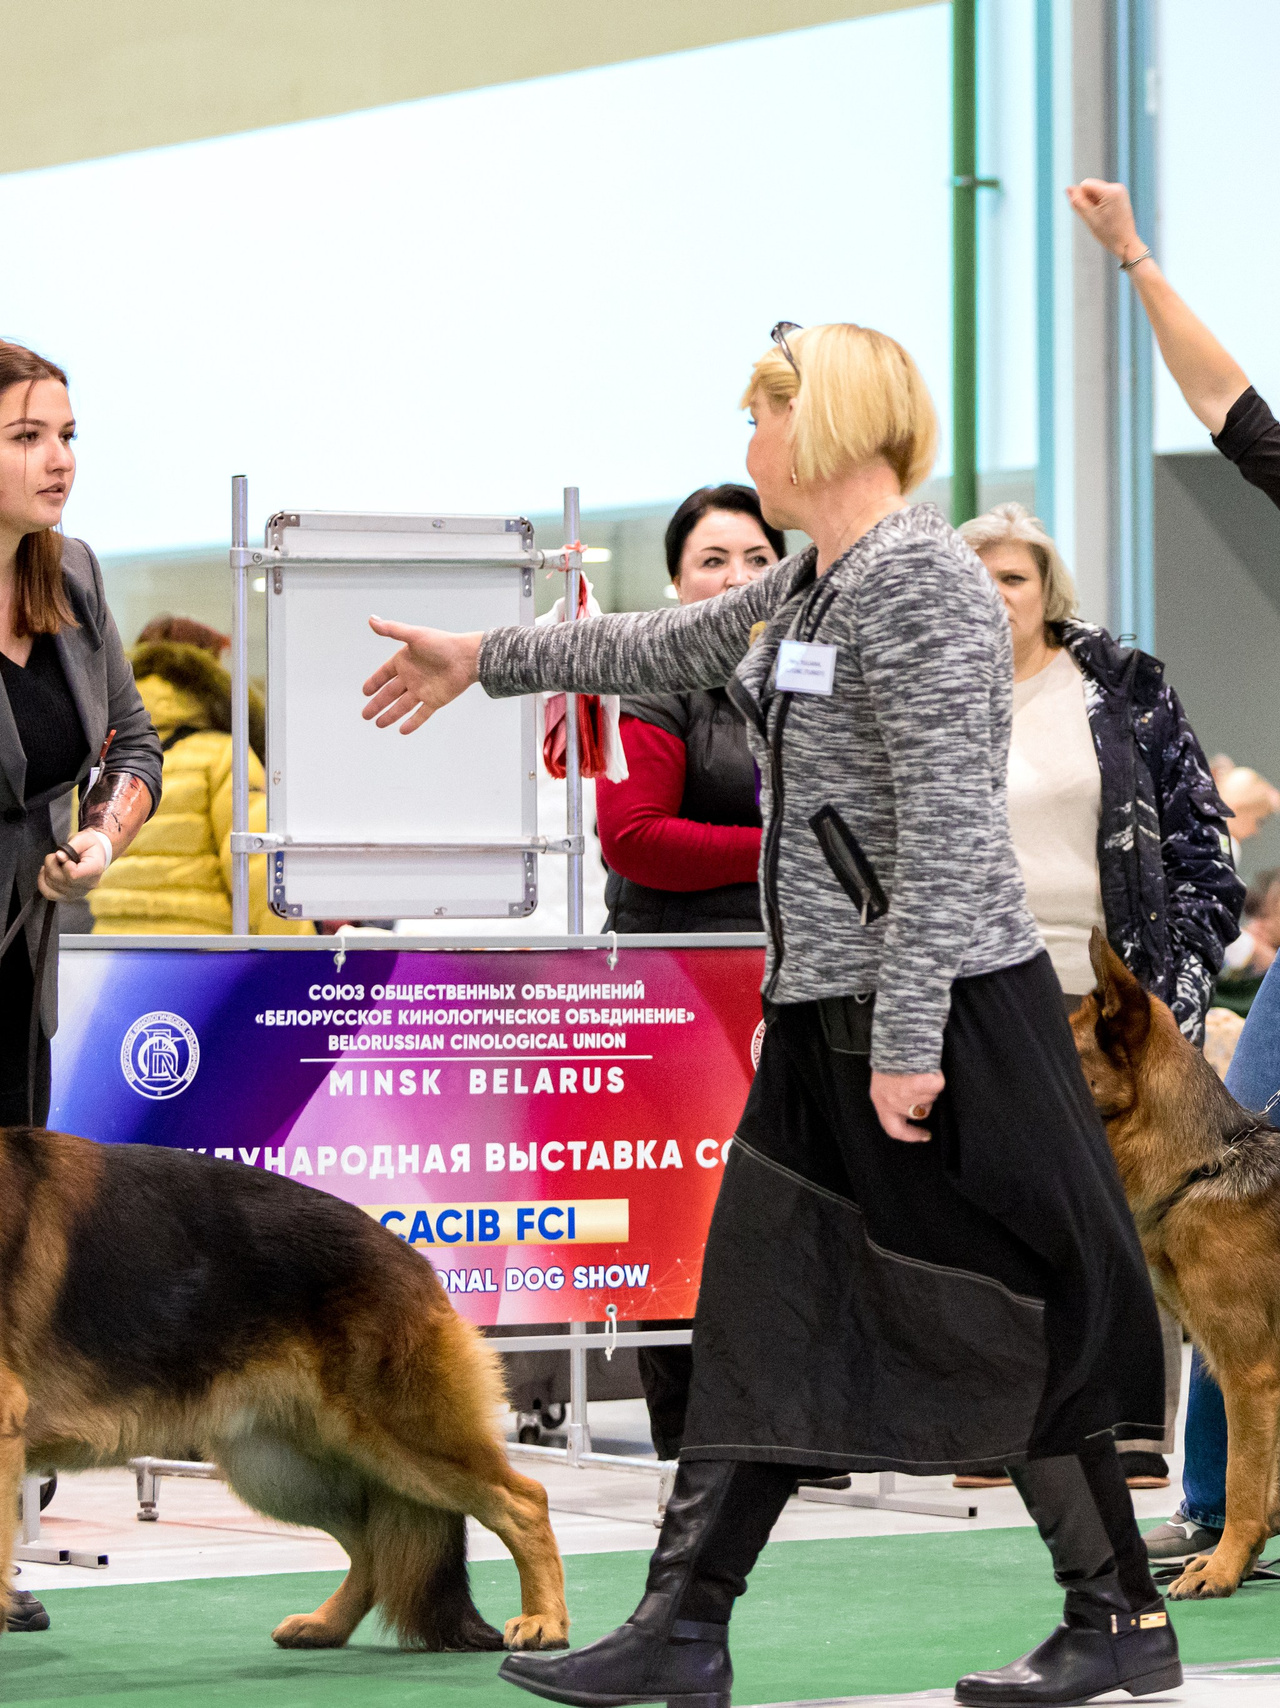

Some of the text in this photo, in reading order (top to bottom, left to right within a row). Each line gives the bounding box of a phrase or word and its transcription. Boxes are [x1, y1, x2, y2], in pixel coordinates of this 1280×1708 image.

[308, 979, 645, 1003] СОЮЗ ОБЩЕСТВЕННЫХ ОБЪЕДИНЕНИЙ
[255, 1007, 696, 1027] «БЕЛОРУССКОЕ КИНОЛОГИЧЕСКОЕ ОБЪЕДИНЕНИЕ»
[328, 1031, 627, 1051] BELORUSSIAN CINOLOGICAL UNION
[329, 1066, 625, 1096] MINSK BELARUS
[185, 1144, 469, 1179] УНАРОДНАЯ
[485, 1139, 683, 1172] ВЫСТАВКА
[380, 1207, 576, 1244] CACIB FCI
[505, 1267, 564, 1291] DOG
[573, 1264, 650, 1289] SHOW
